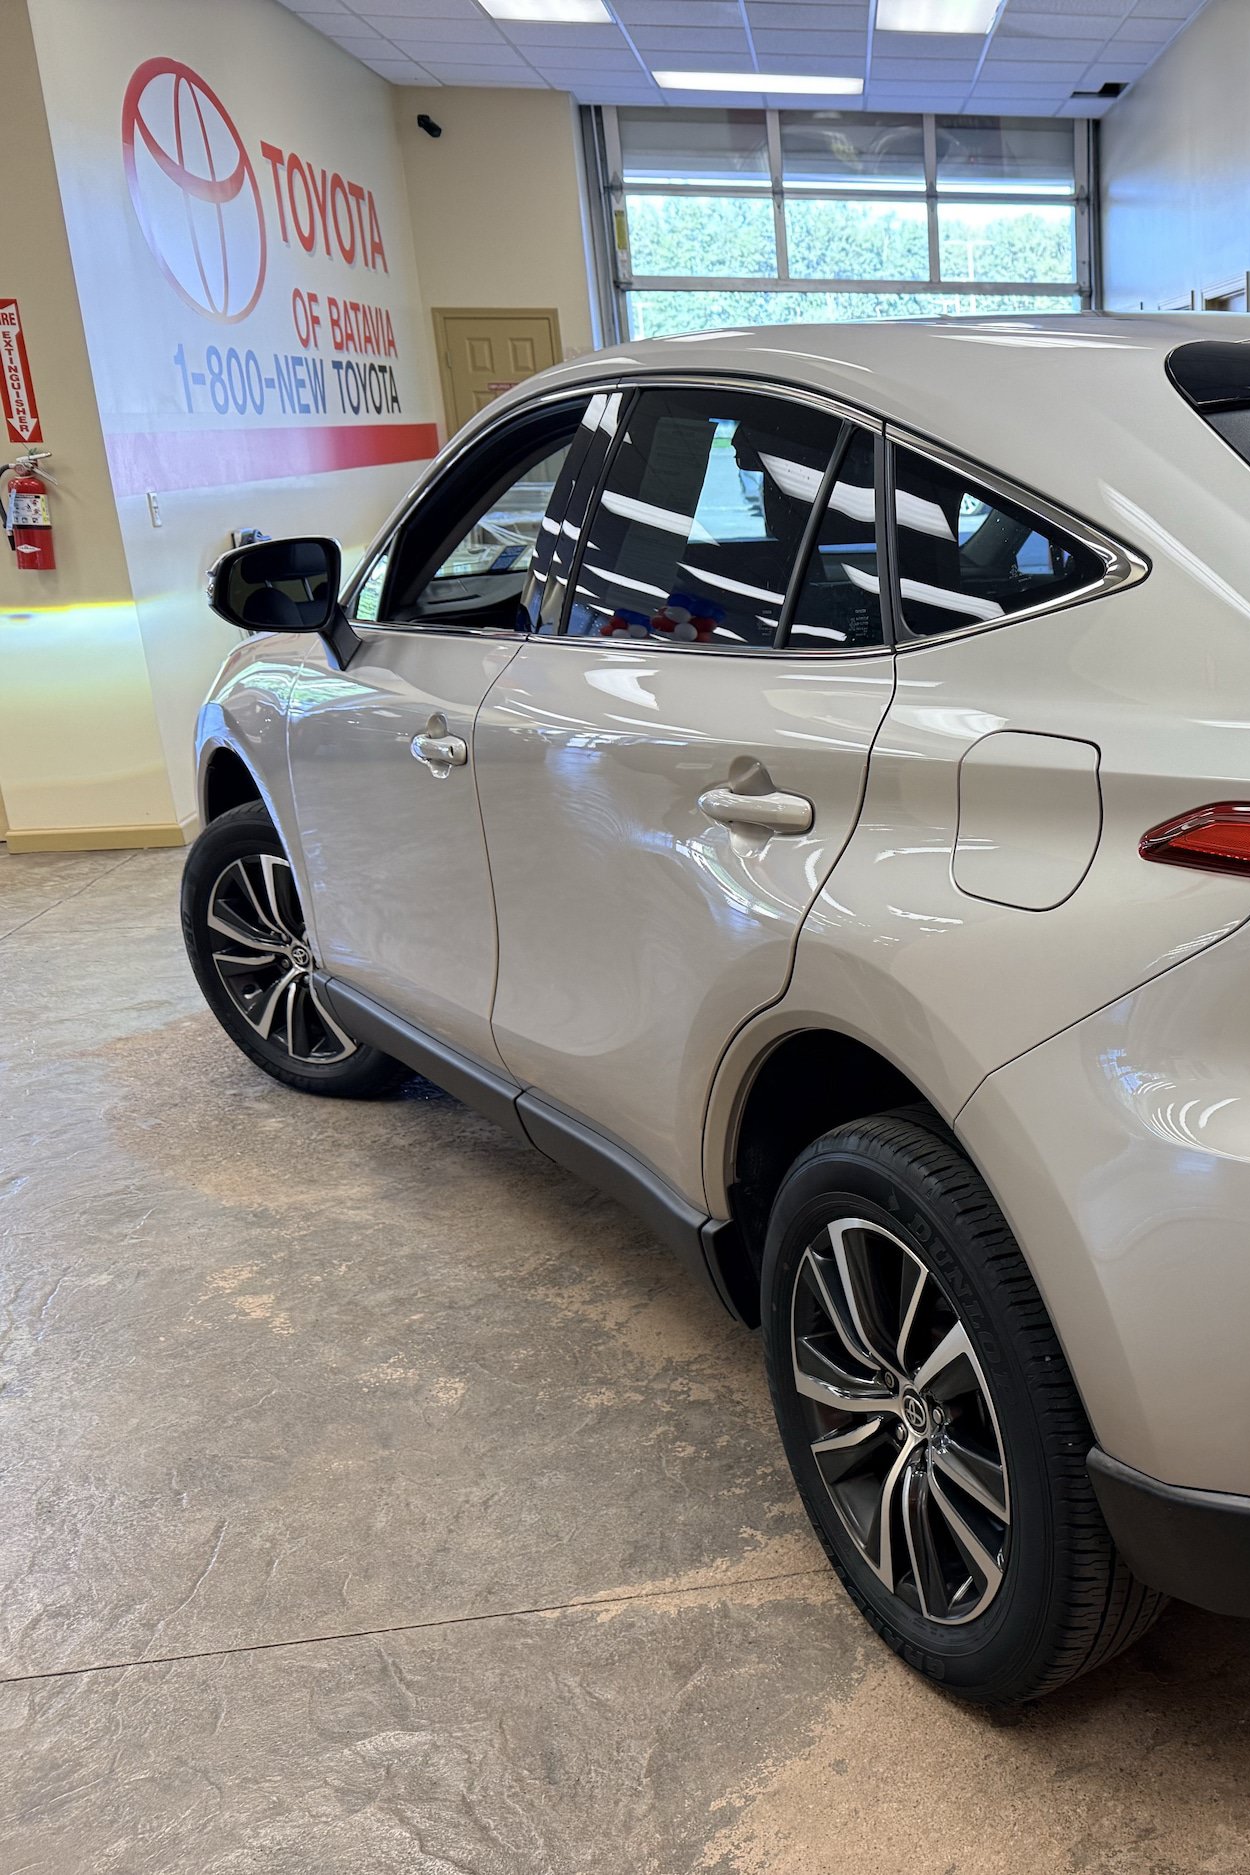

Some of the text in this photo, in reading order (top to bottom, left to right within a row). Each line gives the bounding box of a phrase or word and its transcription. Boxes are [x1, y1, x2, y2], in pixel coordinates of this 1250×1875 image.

[260, 140, 389, 274] TOYOTA
[292, 287, 398, 358] OF BATAVIA
[2, 331, 29, 433] EXTINGUISHER
[173, 343, 402, 415] 1-800-NEW TOYOTA
